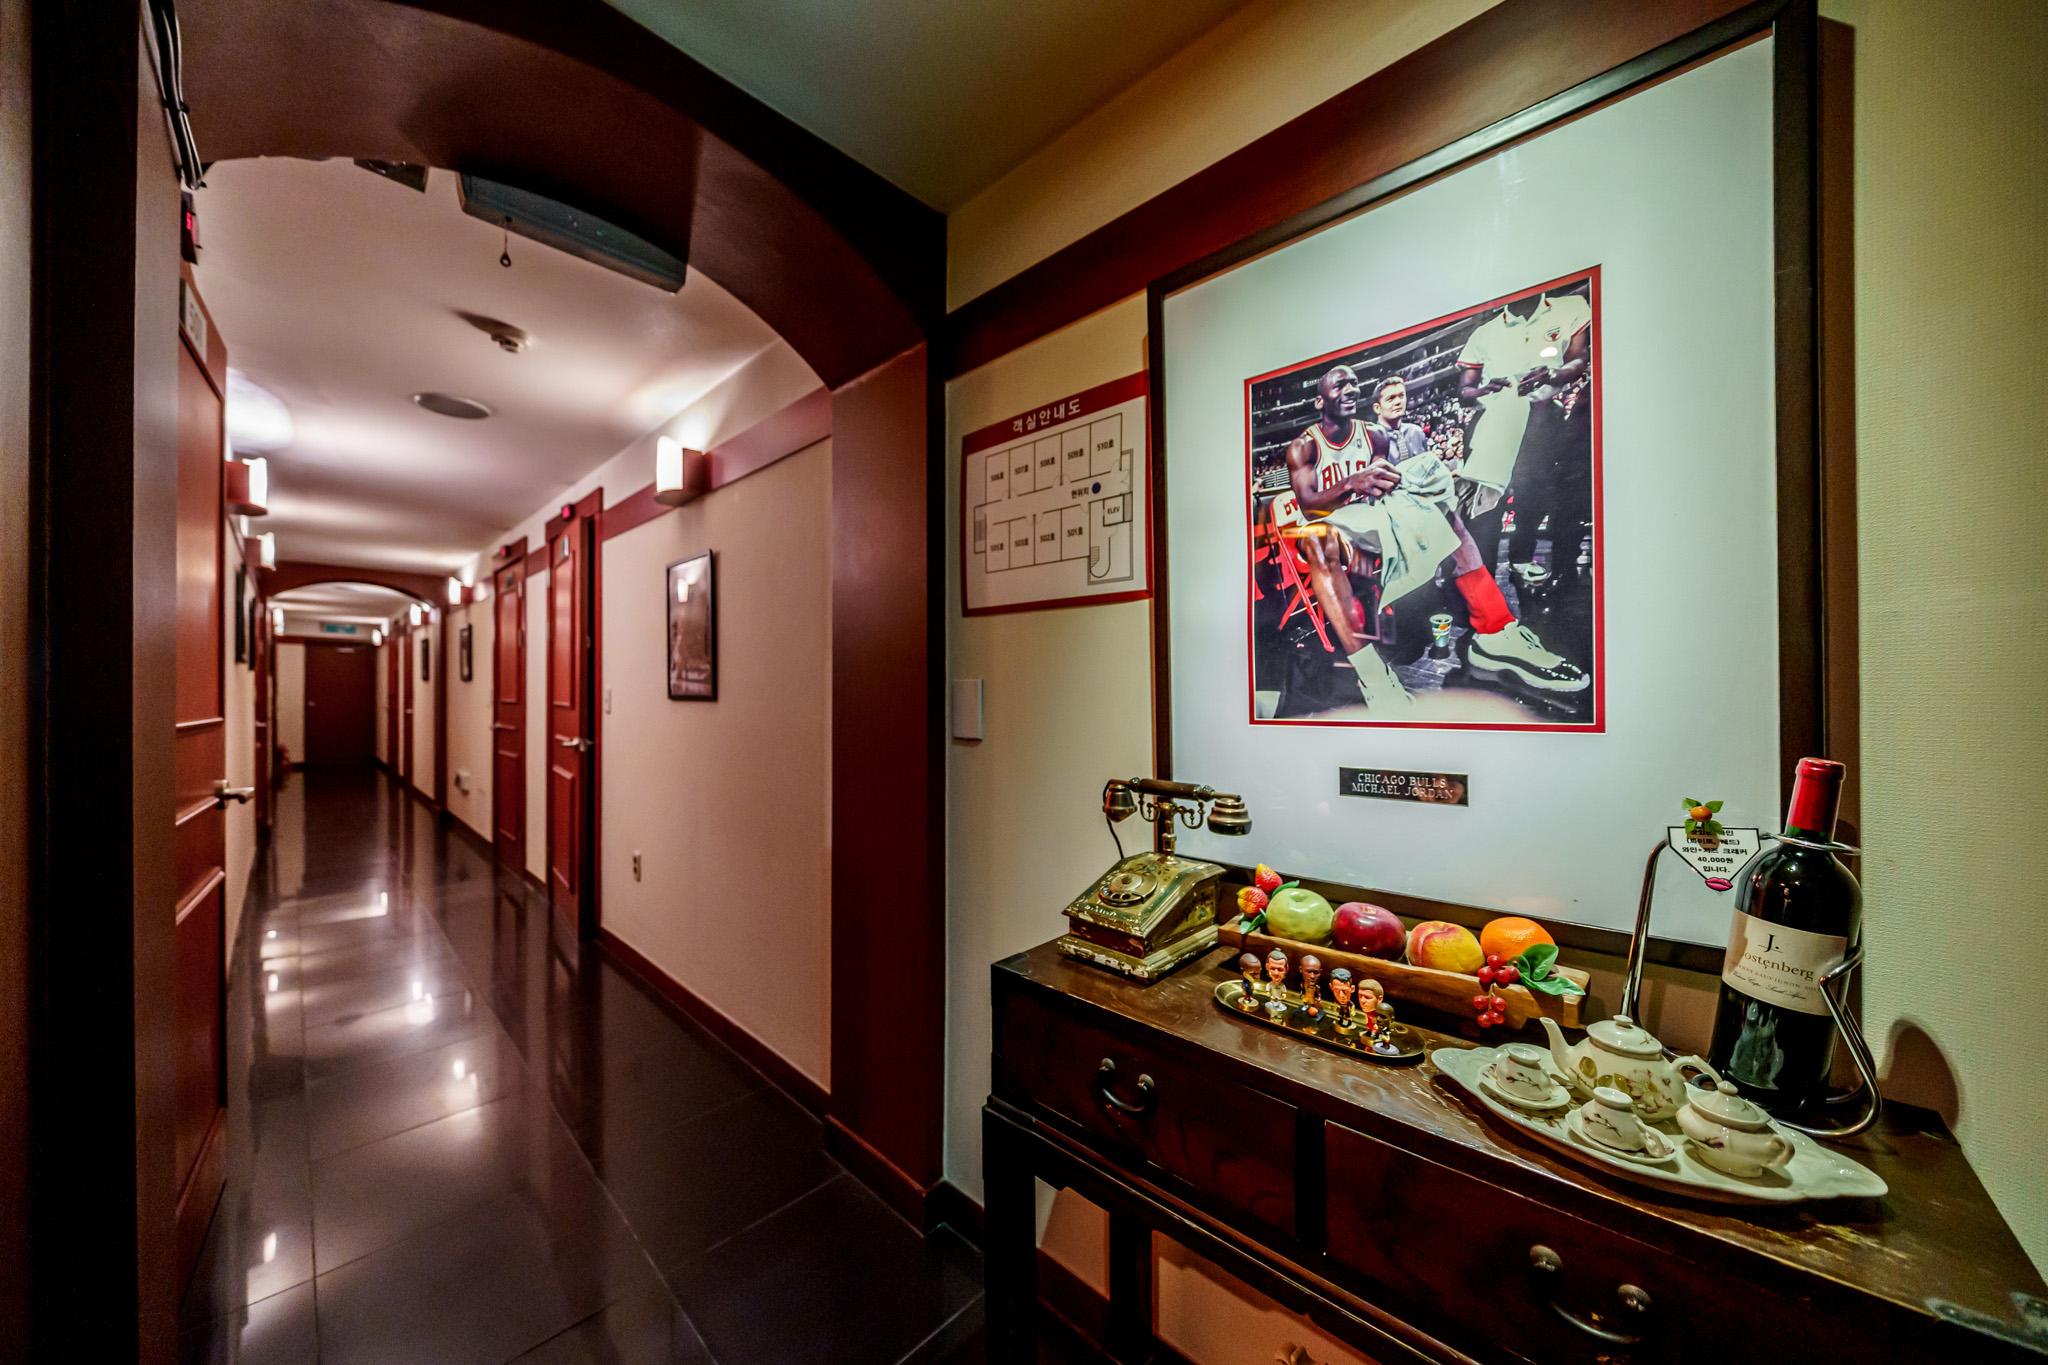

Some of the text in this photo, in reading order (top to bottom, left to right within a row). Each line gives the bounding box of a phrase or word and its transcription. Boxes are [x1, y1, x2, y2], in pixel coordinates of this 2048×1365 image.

[1012, 398, 1081, 433] 객실안내도
[1357, 772, 1447, 788] CHICAGO BULLS
[1351, 782, 1454, 799] MICHAEL JORDAN
